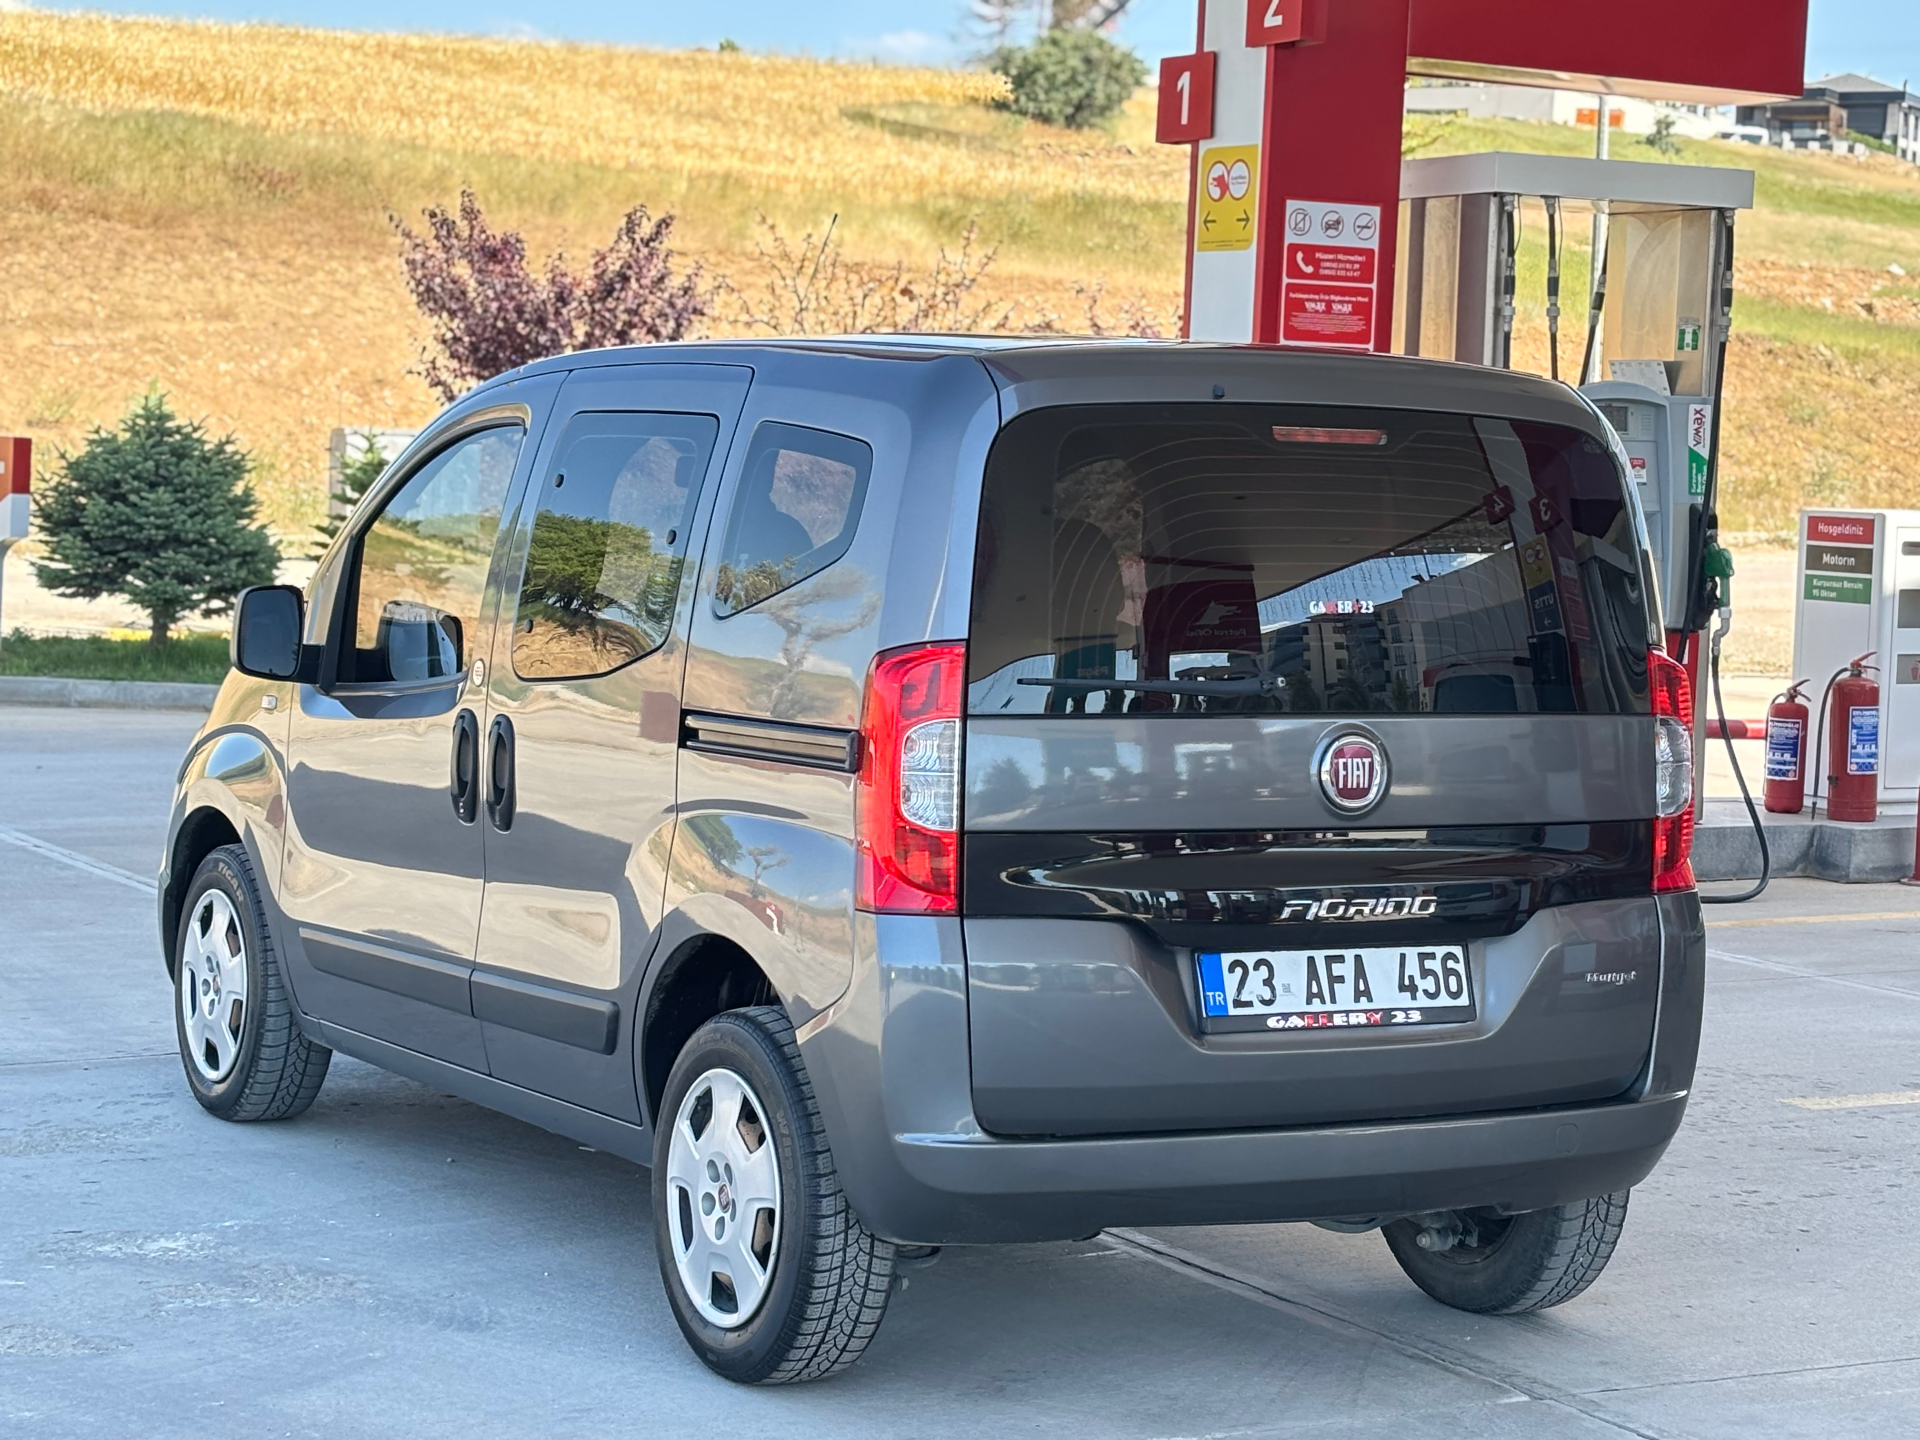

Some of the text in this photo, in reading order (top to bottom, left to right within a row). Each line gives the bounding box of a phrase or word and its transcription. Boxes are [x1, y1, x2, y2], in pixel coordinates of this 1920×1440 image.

[1177, 71, 1191, 125] 1
[1817, 522, 1864, 536] Hoşgeldiniz
[1820, 590, 1837, 598] Oktan
[1843, 580, 1863, 590] Benzin
[1360, 600, 1374, 614] 23
[1338, 758, 1371, 789] FIAT
[217, 861, 244, 901] TIGAR
[1280, 896, 1437, 920] FIORINO
[1227, 951, 1464, 1009] 23 AFA 456
[1206, 991, 1225, 1006] TR
[1266, 1010, 1422, 1029] GALLERY 23
